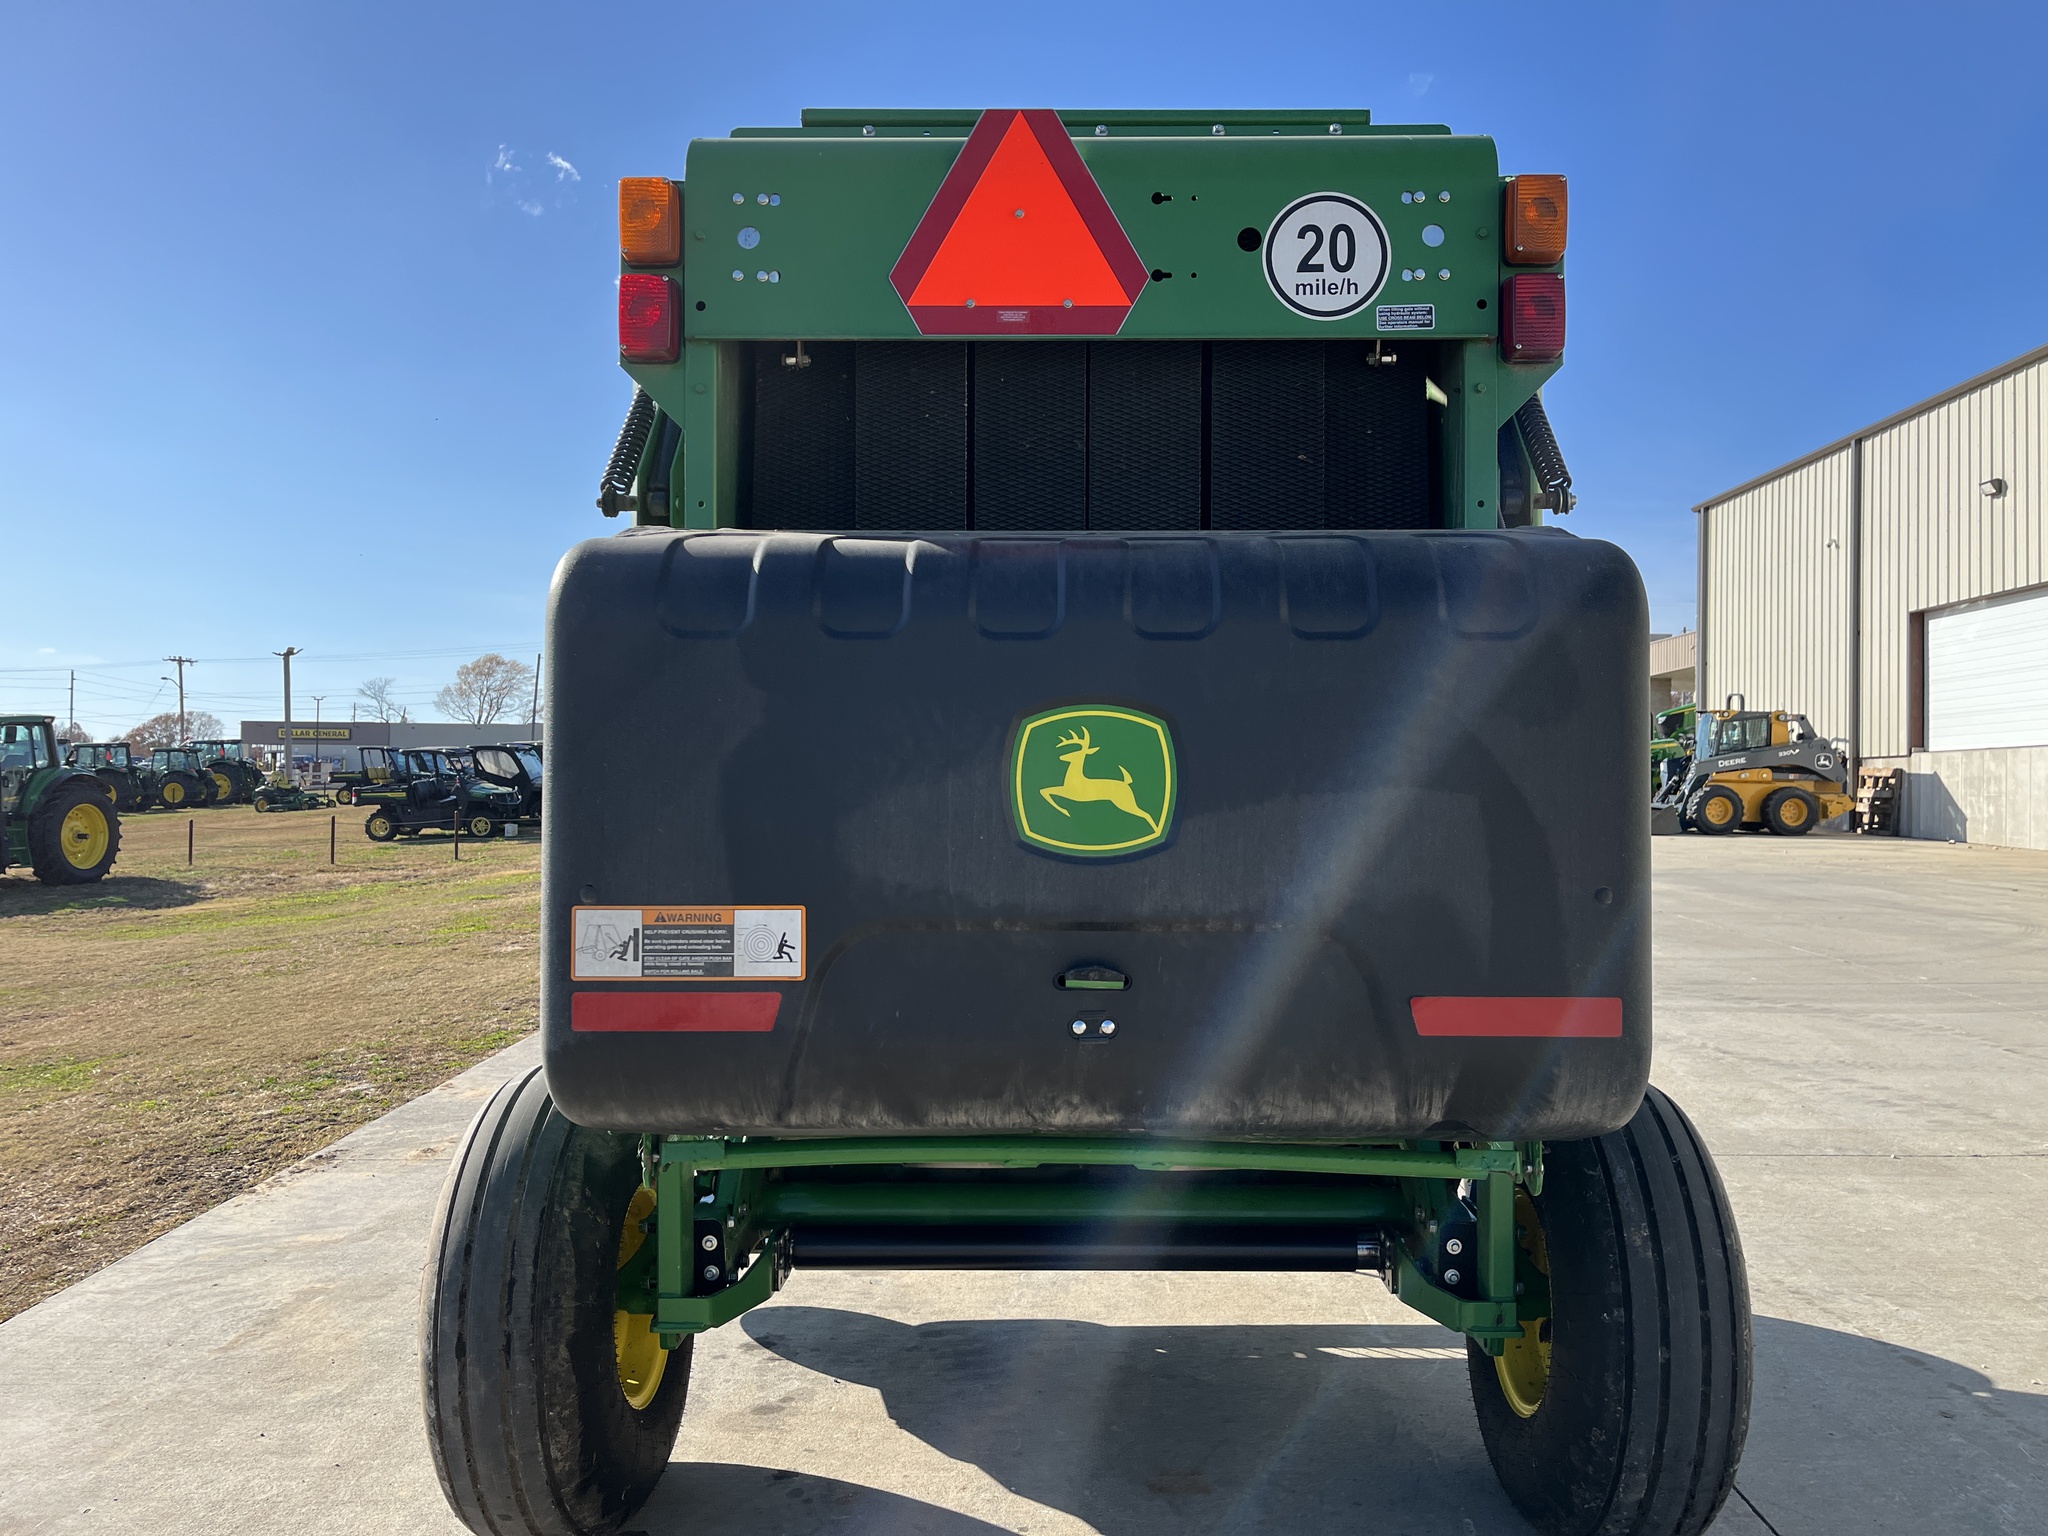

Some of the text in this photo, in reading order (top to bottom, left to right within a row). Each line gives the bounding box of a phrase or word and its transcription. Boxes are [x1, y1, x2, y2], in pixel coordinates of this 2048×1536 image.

[1296, 223, 1356, 273] 20
[1295, 278, 1359, 295] mile/h
[1718, 757, 1747, 768] DEERE
[666, 913, 722, 923] WARNING
